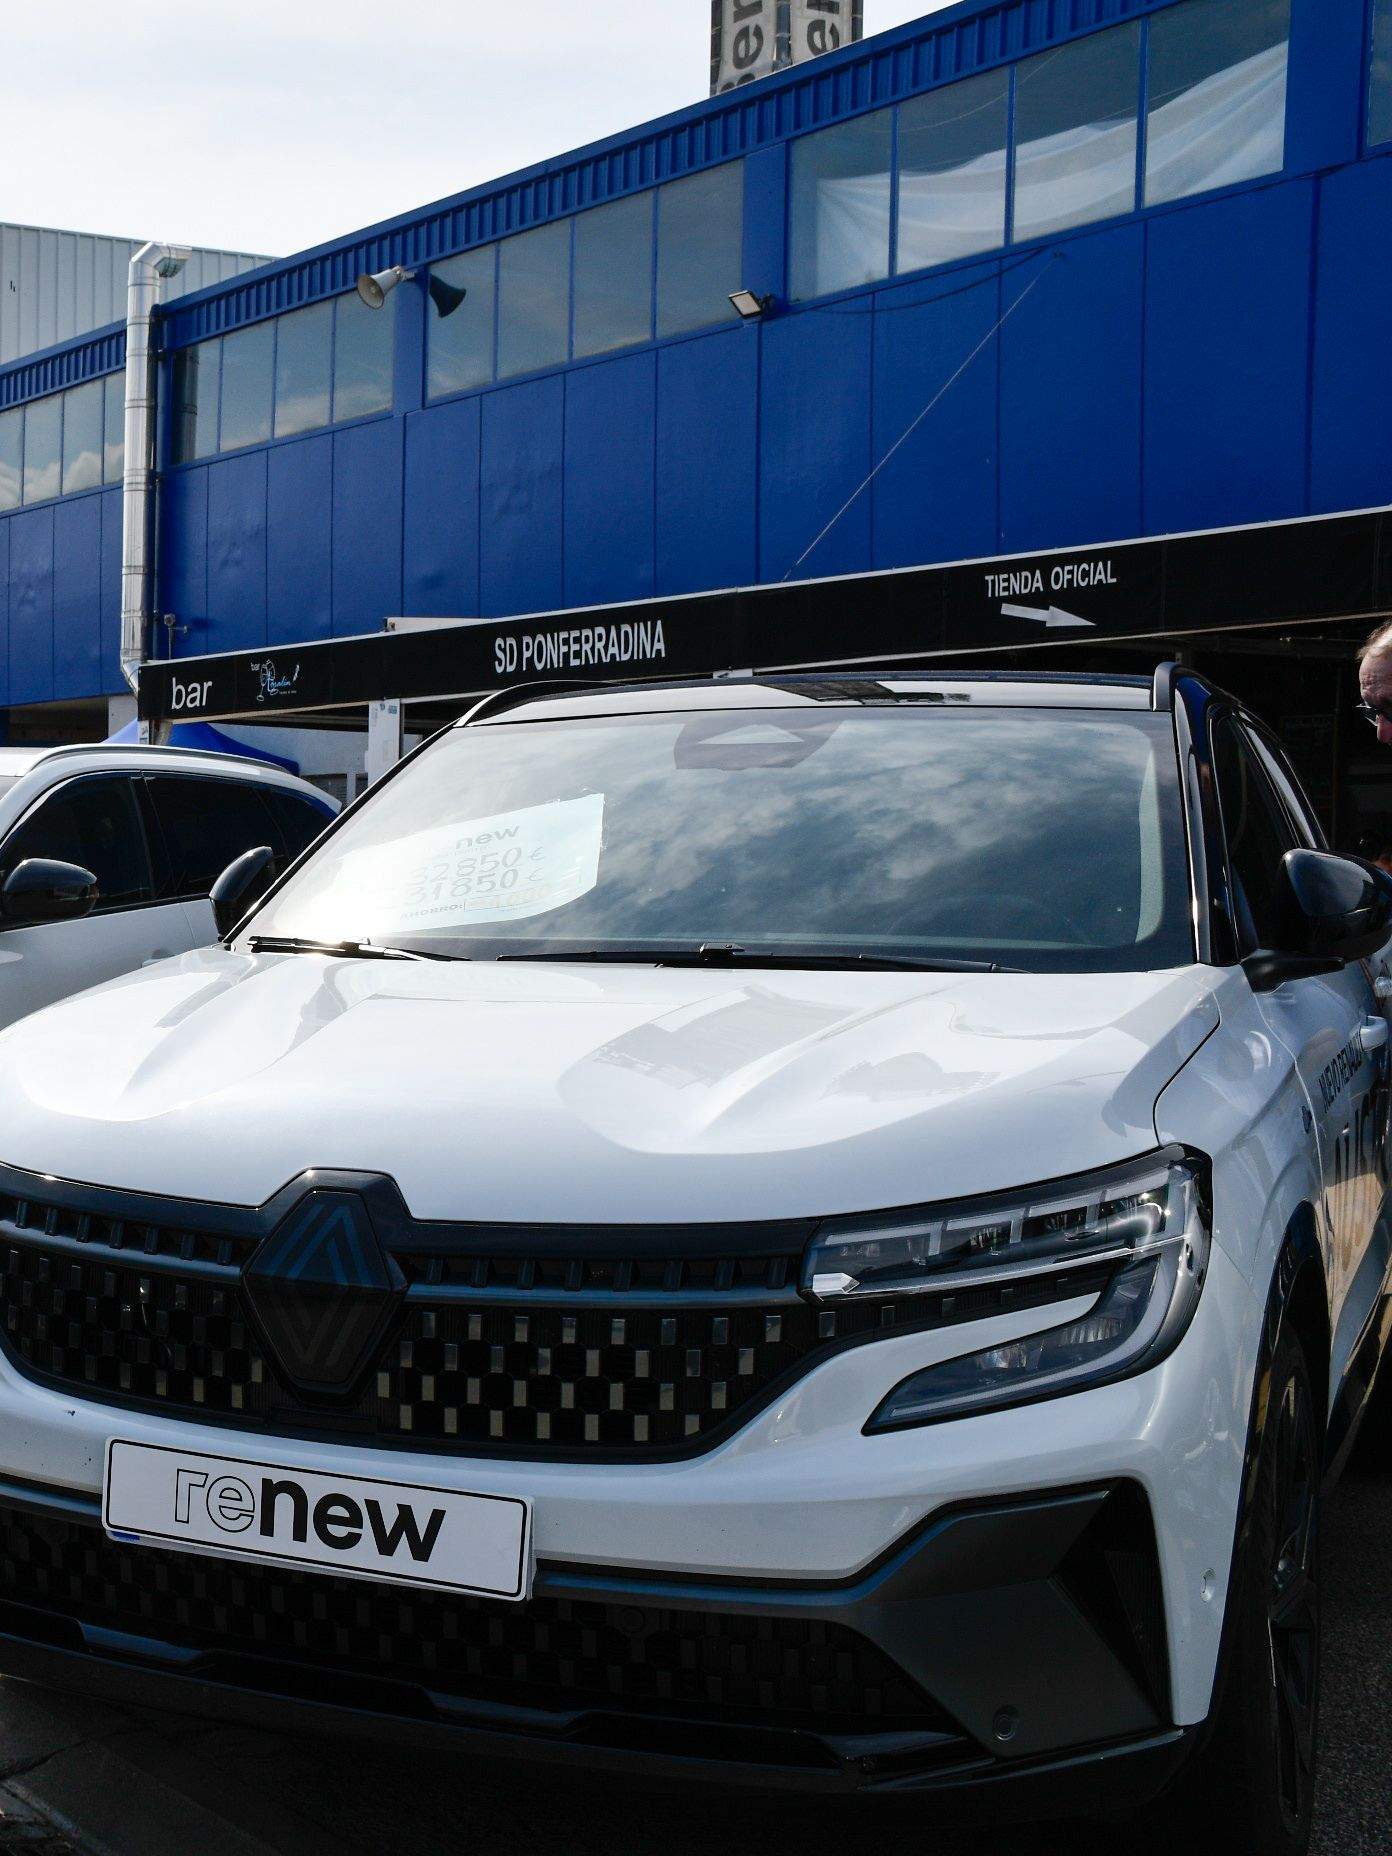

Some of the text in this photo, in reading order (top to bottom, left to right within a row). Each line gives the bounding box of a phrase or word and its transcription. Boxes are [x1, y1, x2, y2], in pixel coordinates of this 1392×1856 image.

[984, 560, 1117, 598] TIENDA OFICIAL
[494, 619, 666, 674] SD PONFERRADINA
[171, 676, 212, 710] bar
[456, 847, 522, 877] 850
[450, 869, 519, 897] 850
[174, 1467, 446, 1563] renew
